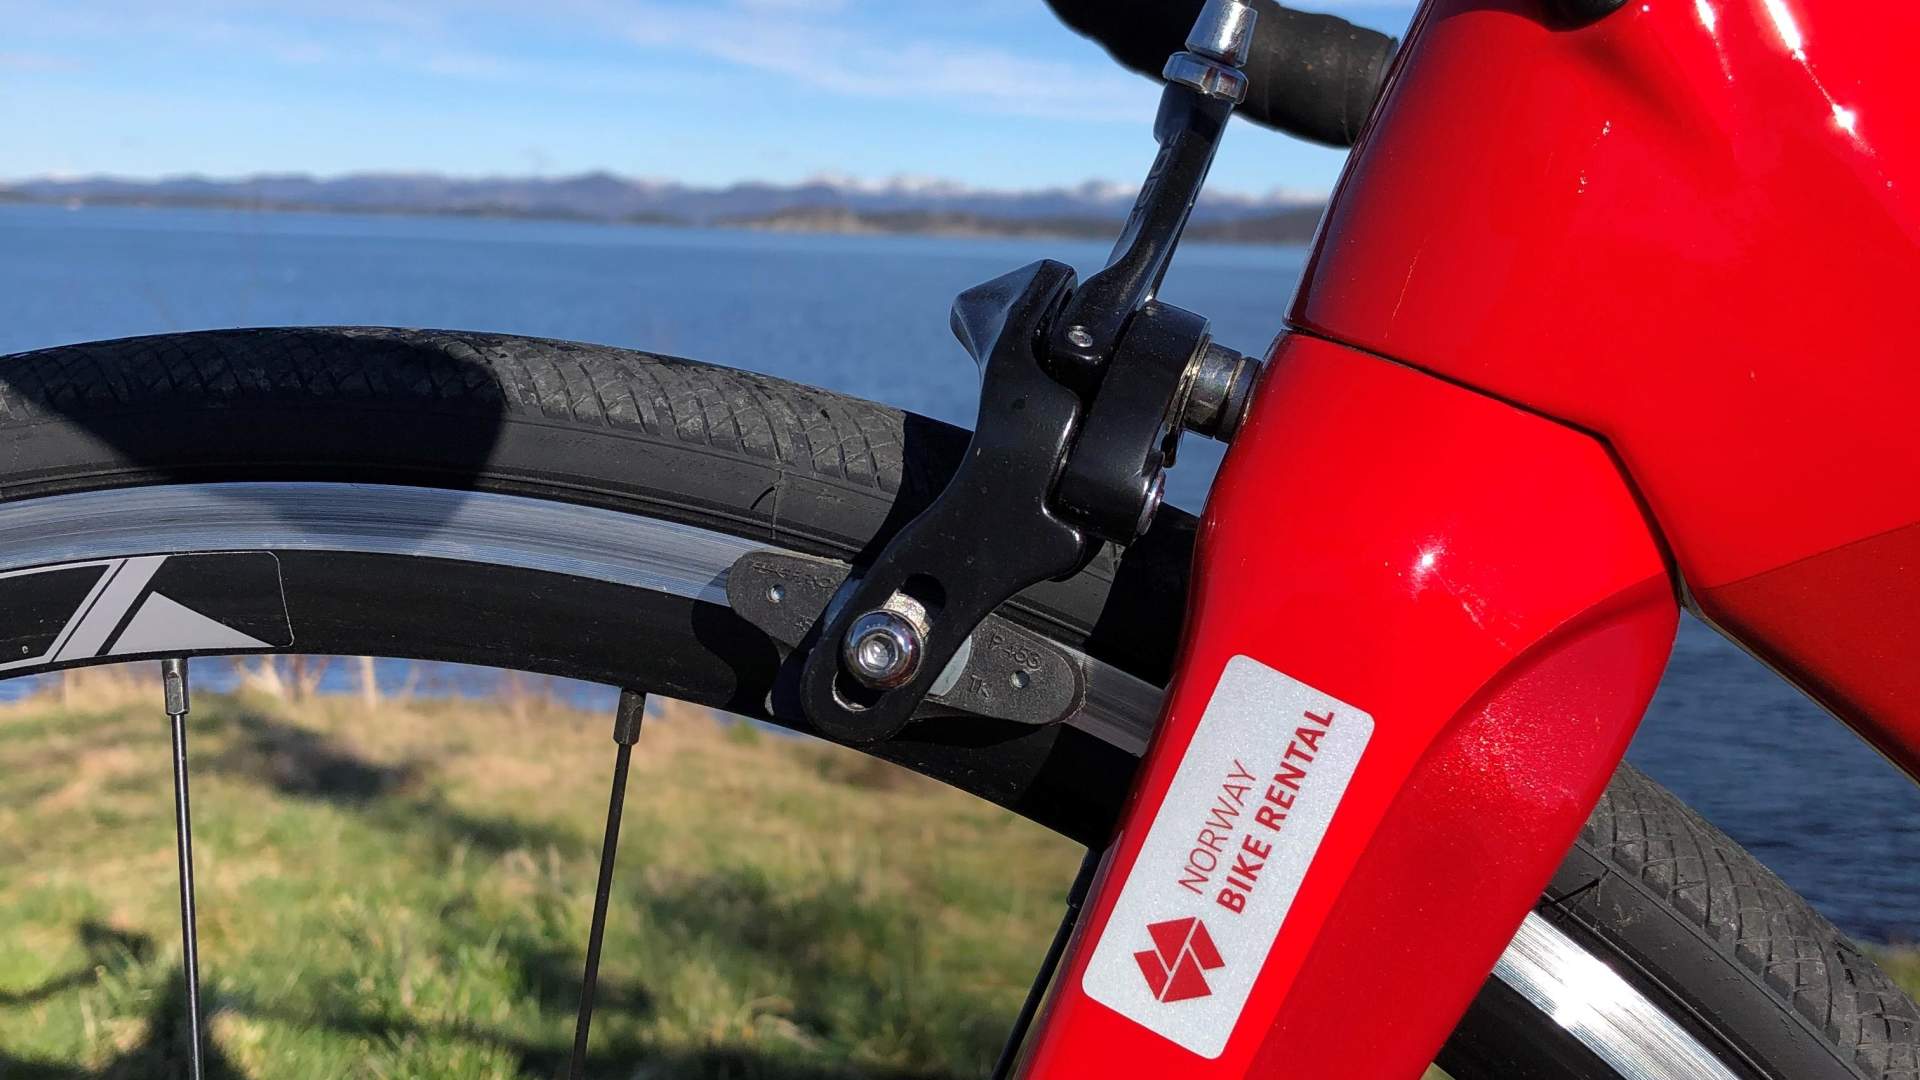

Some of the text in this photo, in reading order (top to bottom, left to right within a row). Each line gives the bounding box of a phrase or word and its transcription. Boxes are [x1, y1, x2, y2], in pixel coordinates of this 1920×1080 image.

[1178, 759, 1257, 894] NORWAY
[1216, 710, 1335, 914] BIKE RENTAL
